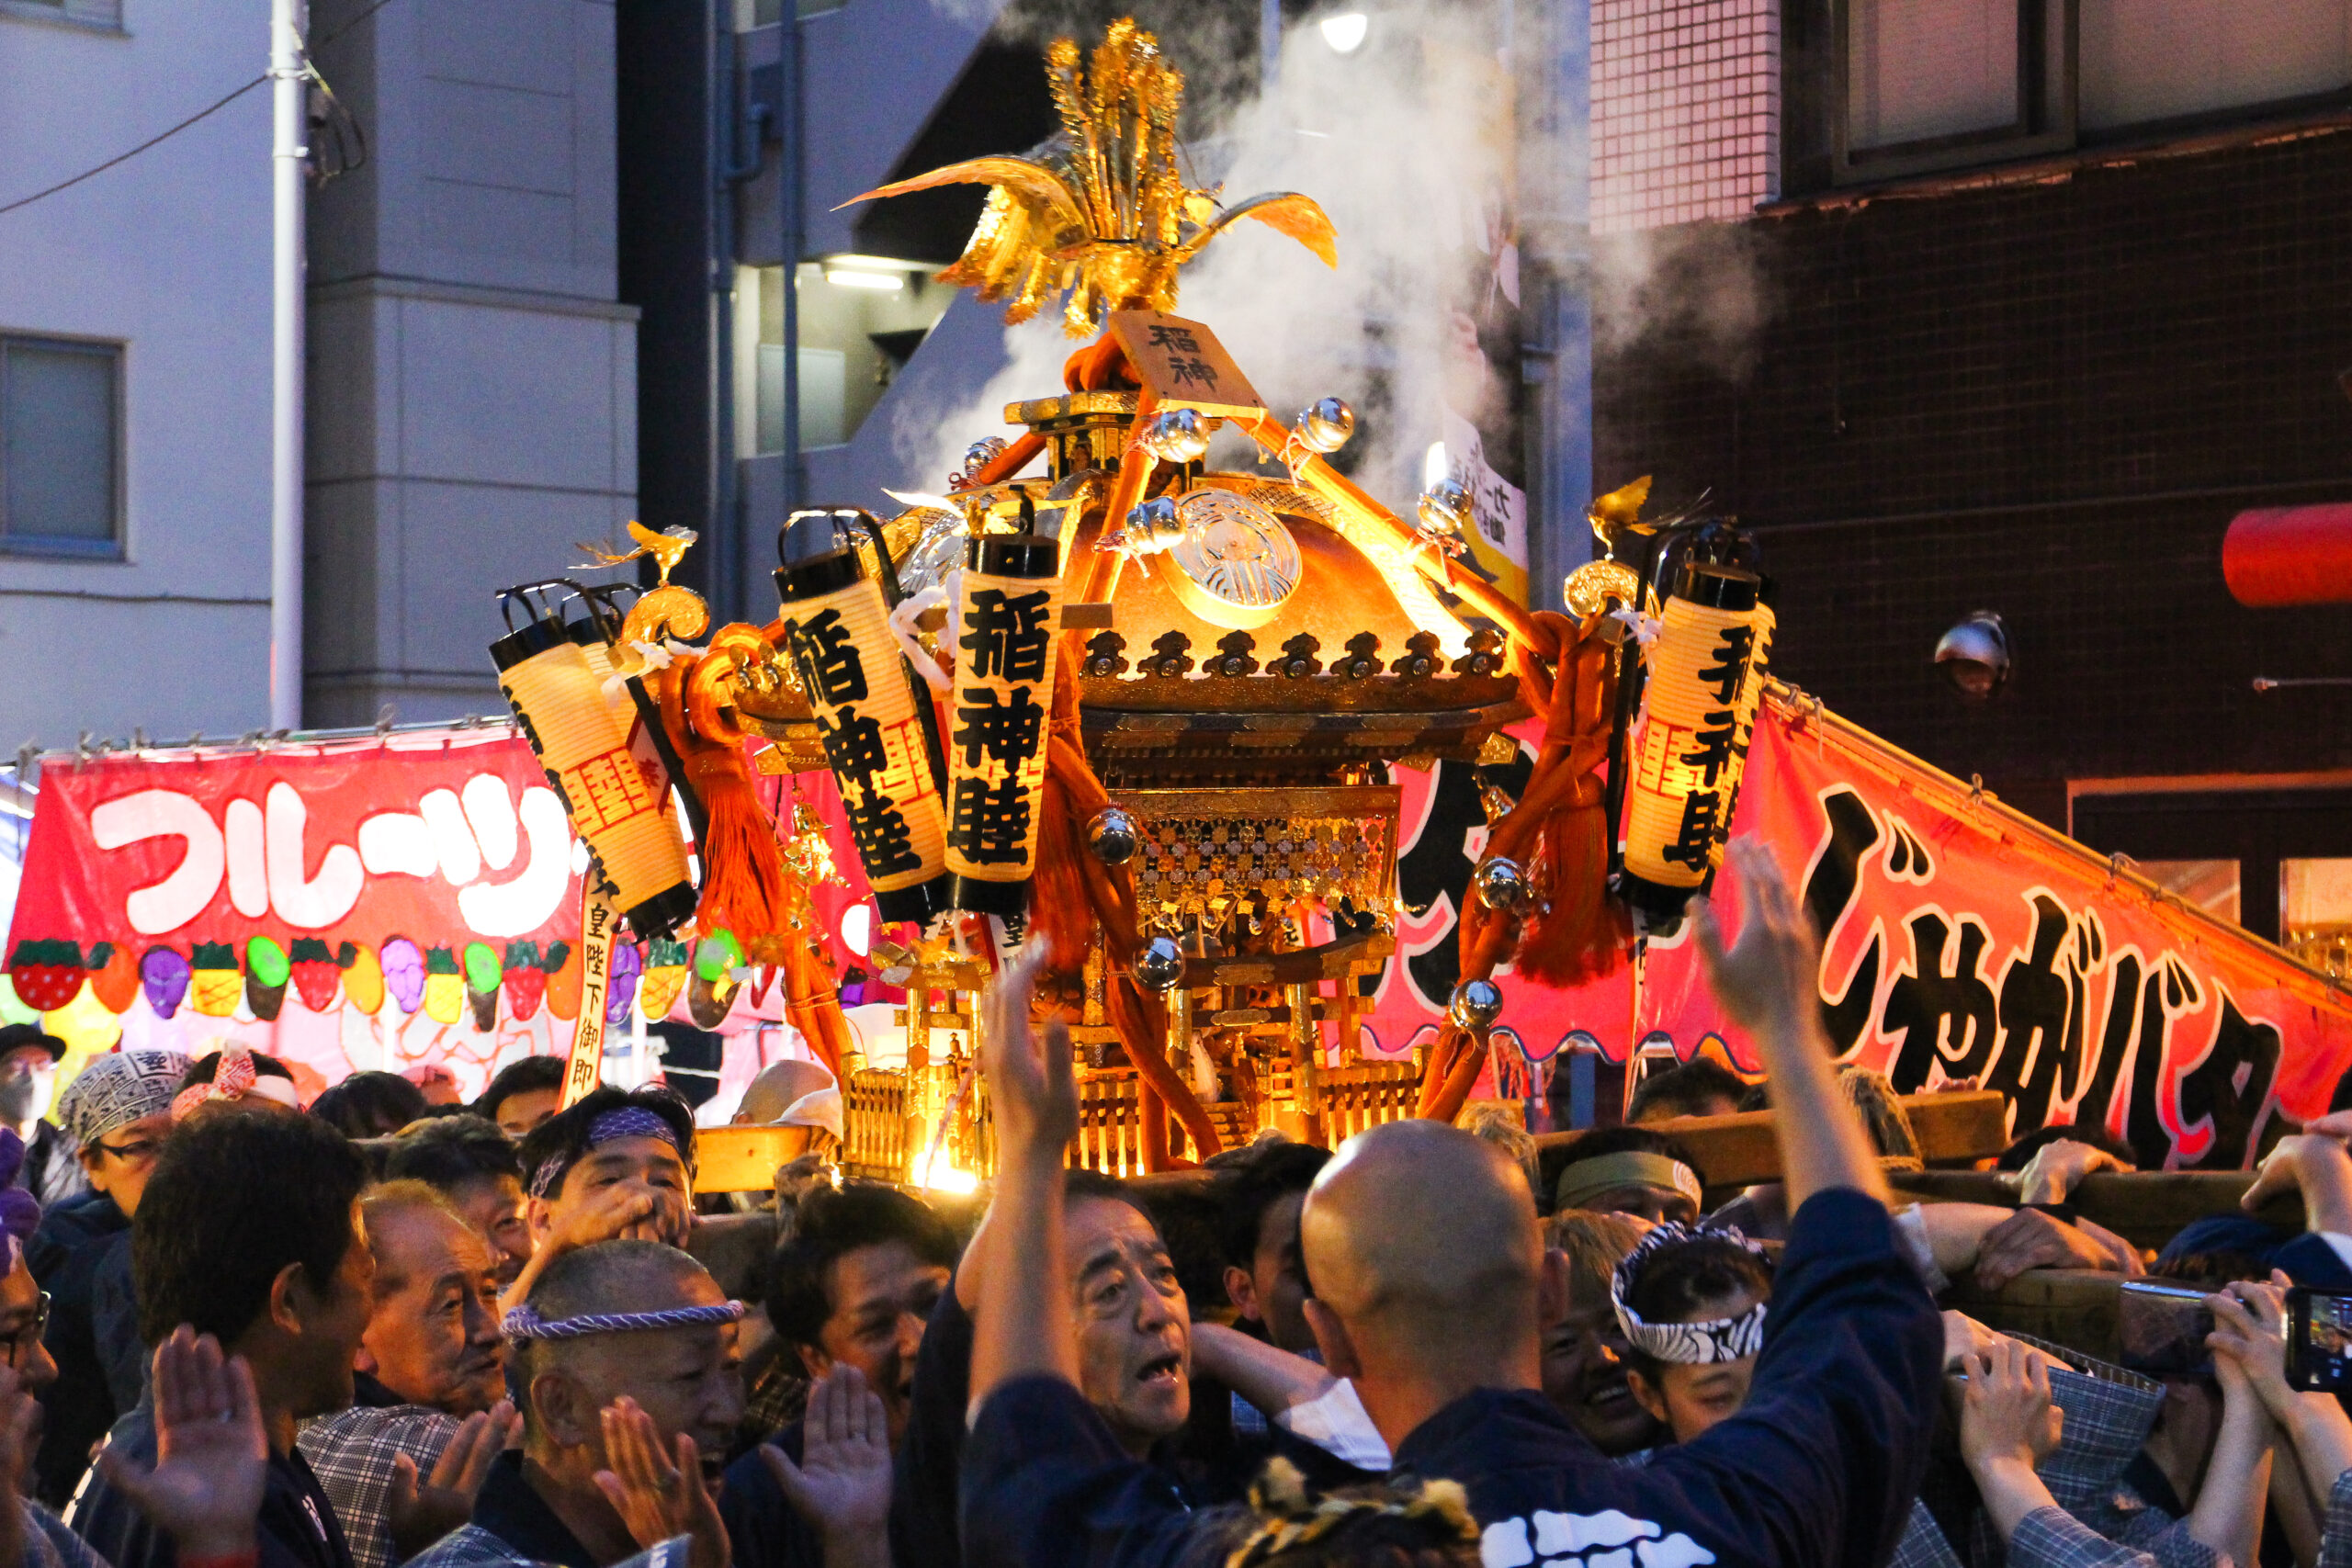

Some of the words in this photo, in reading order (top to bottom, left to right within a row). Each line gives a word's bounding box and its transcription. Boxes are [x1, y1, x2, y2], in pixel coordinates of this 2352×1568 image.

[946, 588, 1050, 866] 稲神睦
[570, 868, 612, 1106] 皇陛下御即
[1801, 782, 2303, 1172] じゃがバタ
